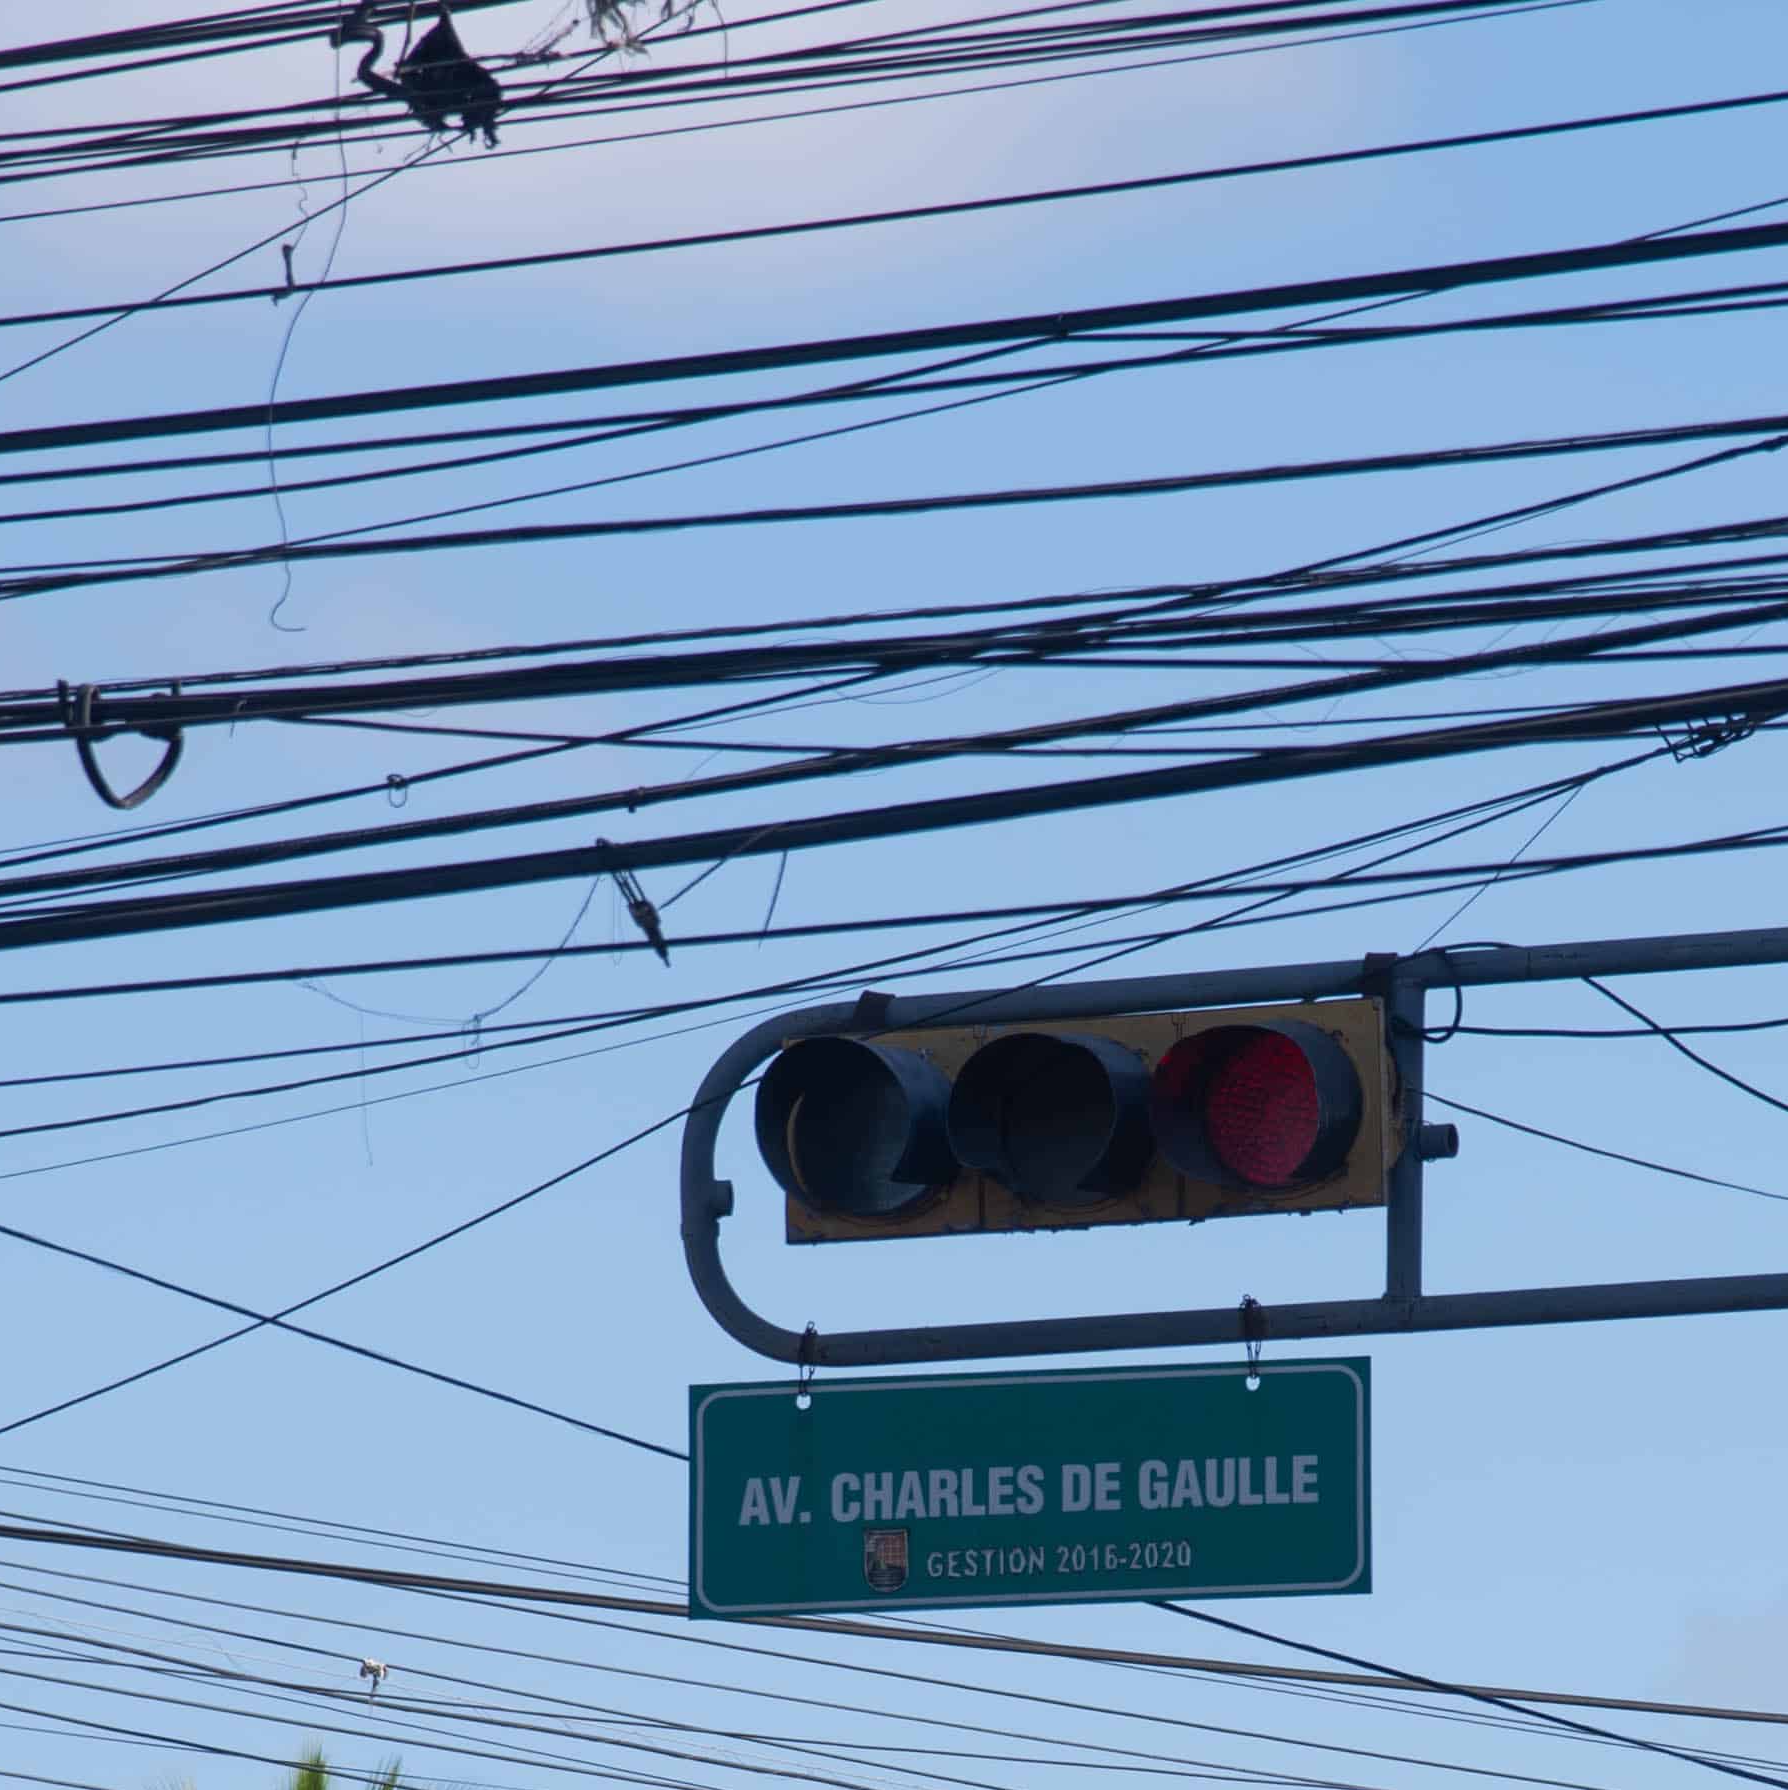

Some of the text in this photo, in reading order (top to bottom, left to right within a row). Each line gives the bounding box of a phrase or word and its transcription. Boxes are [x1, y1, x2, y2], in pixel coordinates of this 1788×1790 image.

[738, 1455, 1318, 1526] AV. CHARLES DE GAULLE
[926, 1541, 1192, 1577] GESTION 2016-2020
